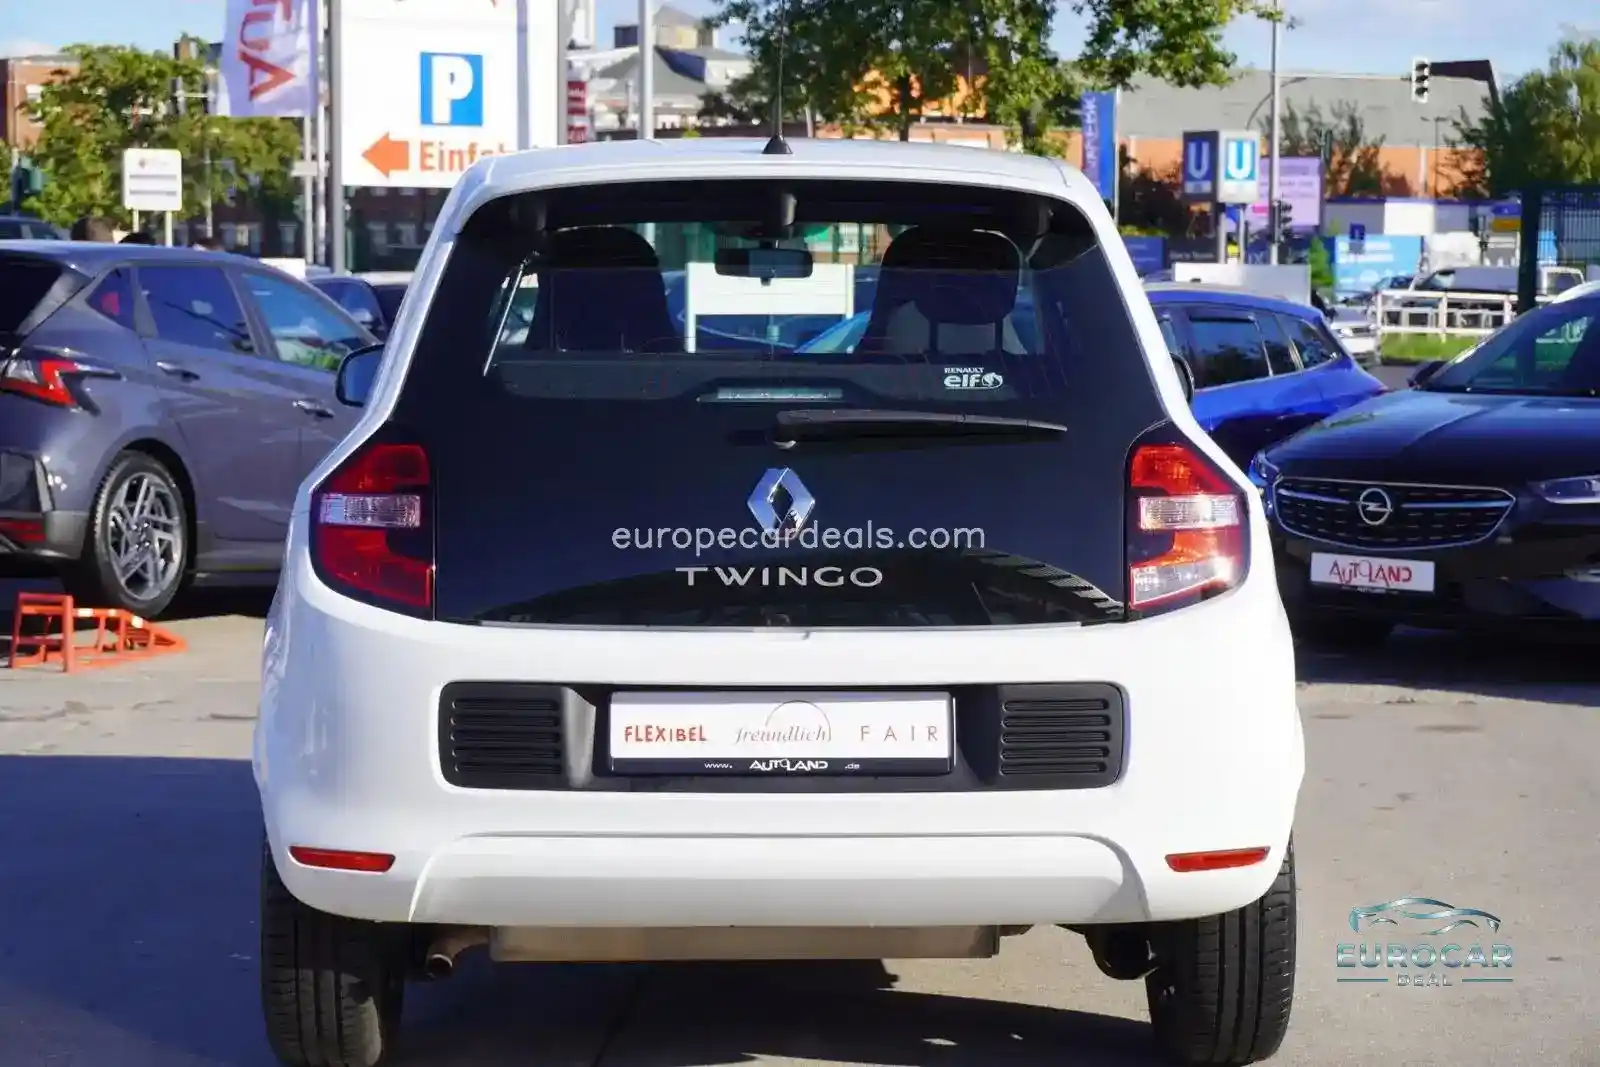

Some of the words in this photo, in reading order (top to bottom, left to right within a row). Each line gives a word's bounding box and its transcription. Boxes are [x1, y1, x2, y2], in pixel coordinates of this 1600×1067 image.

[431, 56, 474, 125] P
[1188, 142, 1210, 179] U
[1227, 141, 1251, 179] U
[943, 374, 981, 387] elf
[675, 566, 883, 587] TWINGO
[625, 725, 707, 742] FLEXIBEL
[735, 725, 826, 744] freundlich
[860, 725, 938, 741] FAIR
